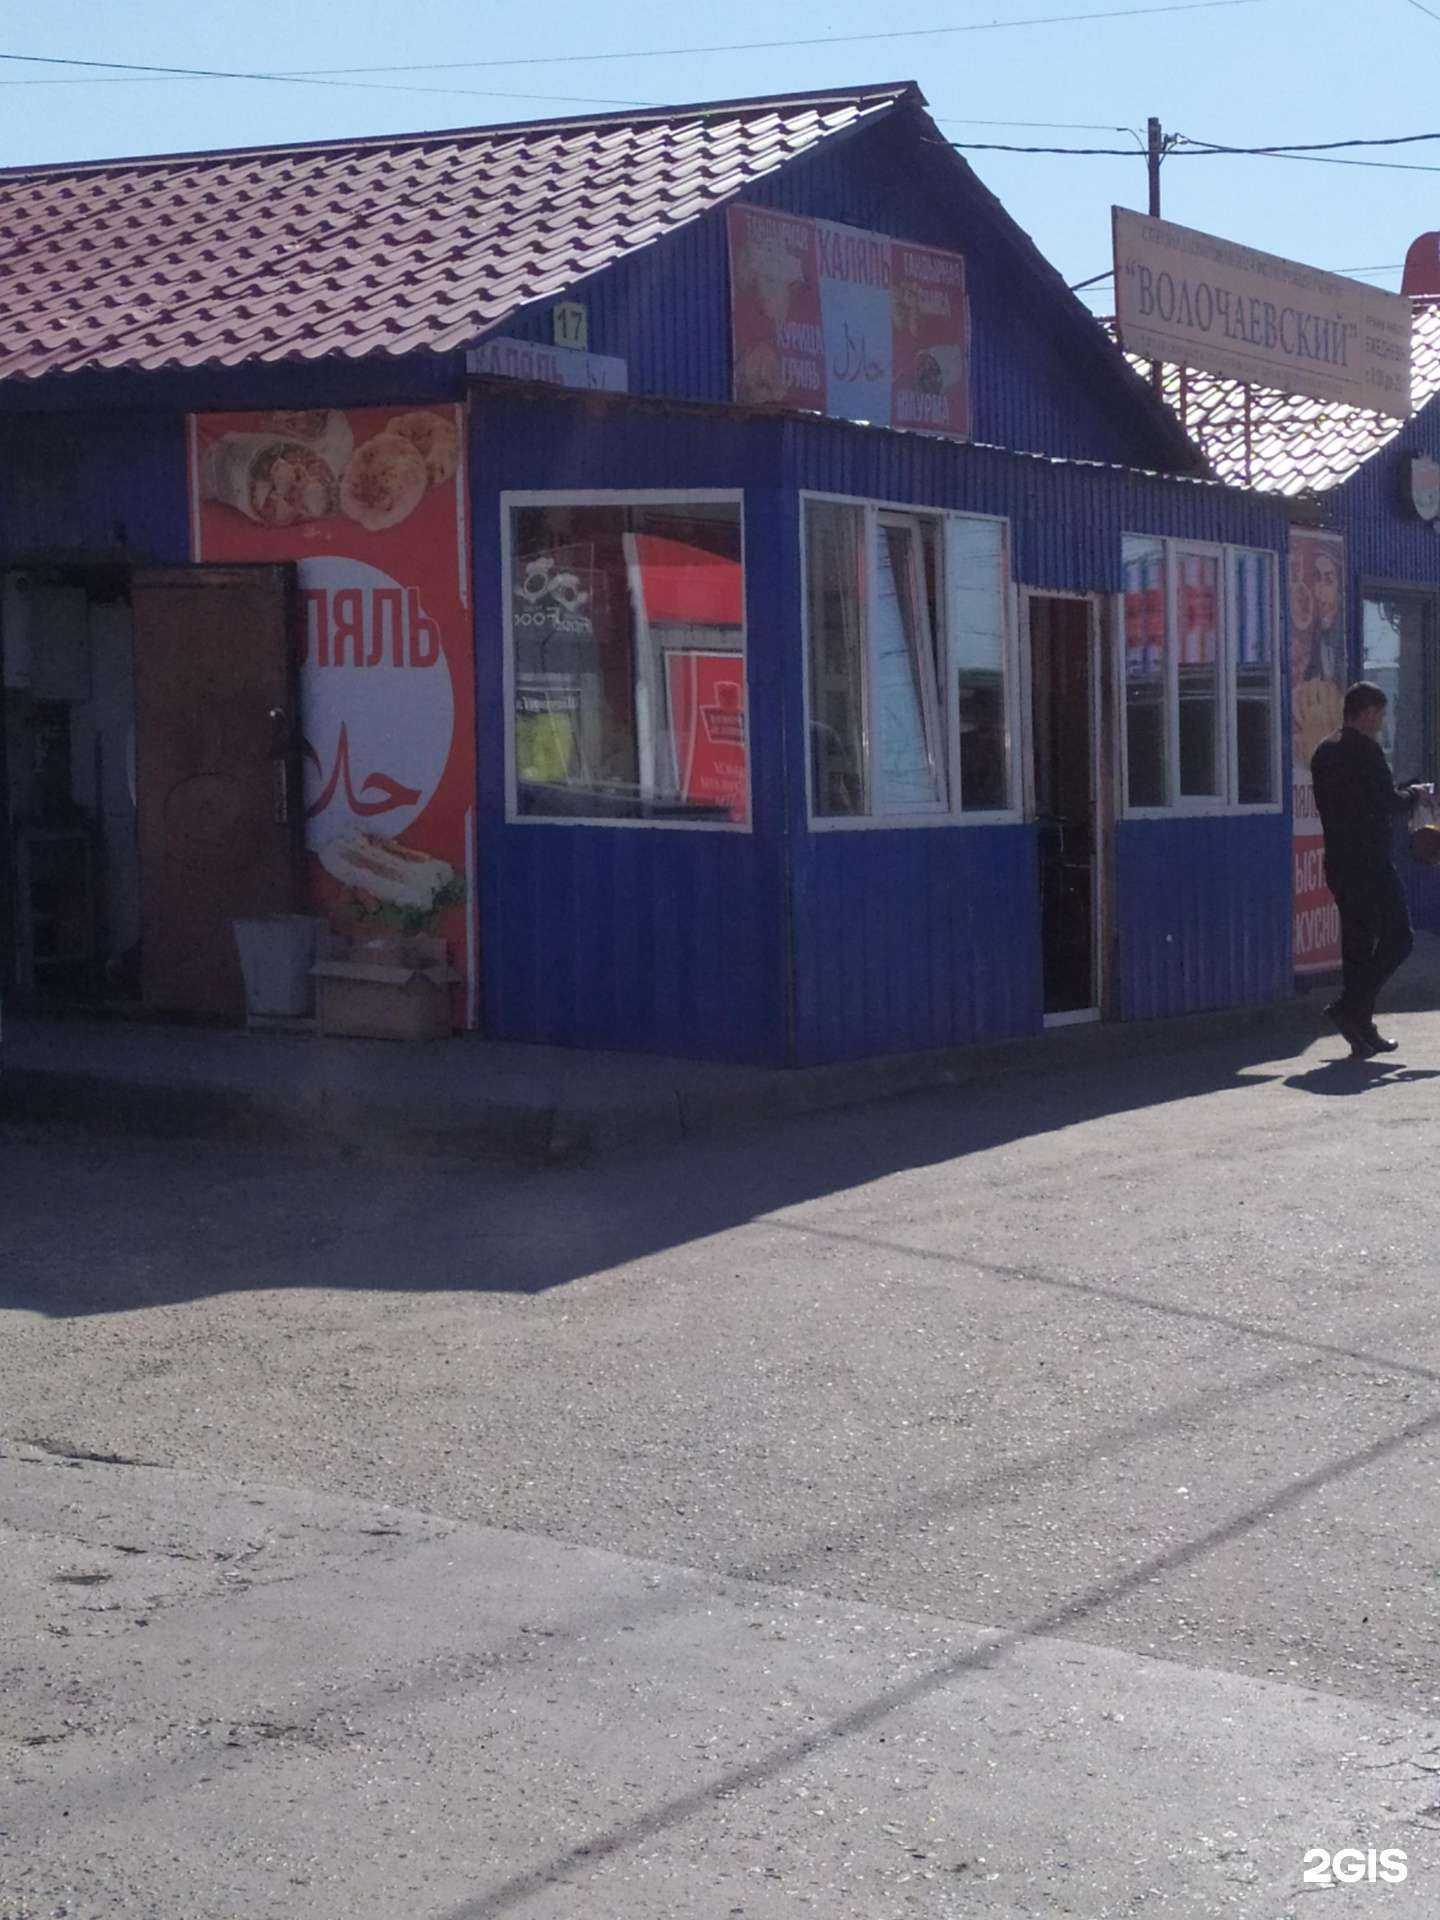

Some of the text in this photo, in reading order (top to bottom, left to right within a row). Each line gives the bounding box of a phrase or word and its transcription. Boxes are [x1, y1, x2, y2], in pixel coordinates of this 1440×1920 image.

[557, 308, 582, 341] 17
[303, 587, 440, 668] ЛЯЛЬ
[1295, 848, 1326, 895] ЫСТ
[1295, 902, 1339, 956] КУСНО
